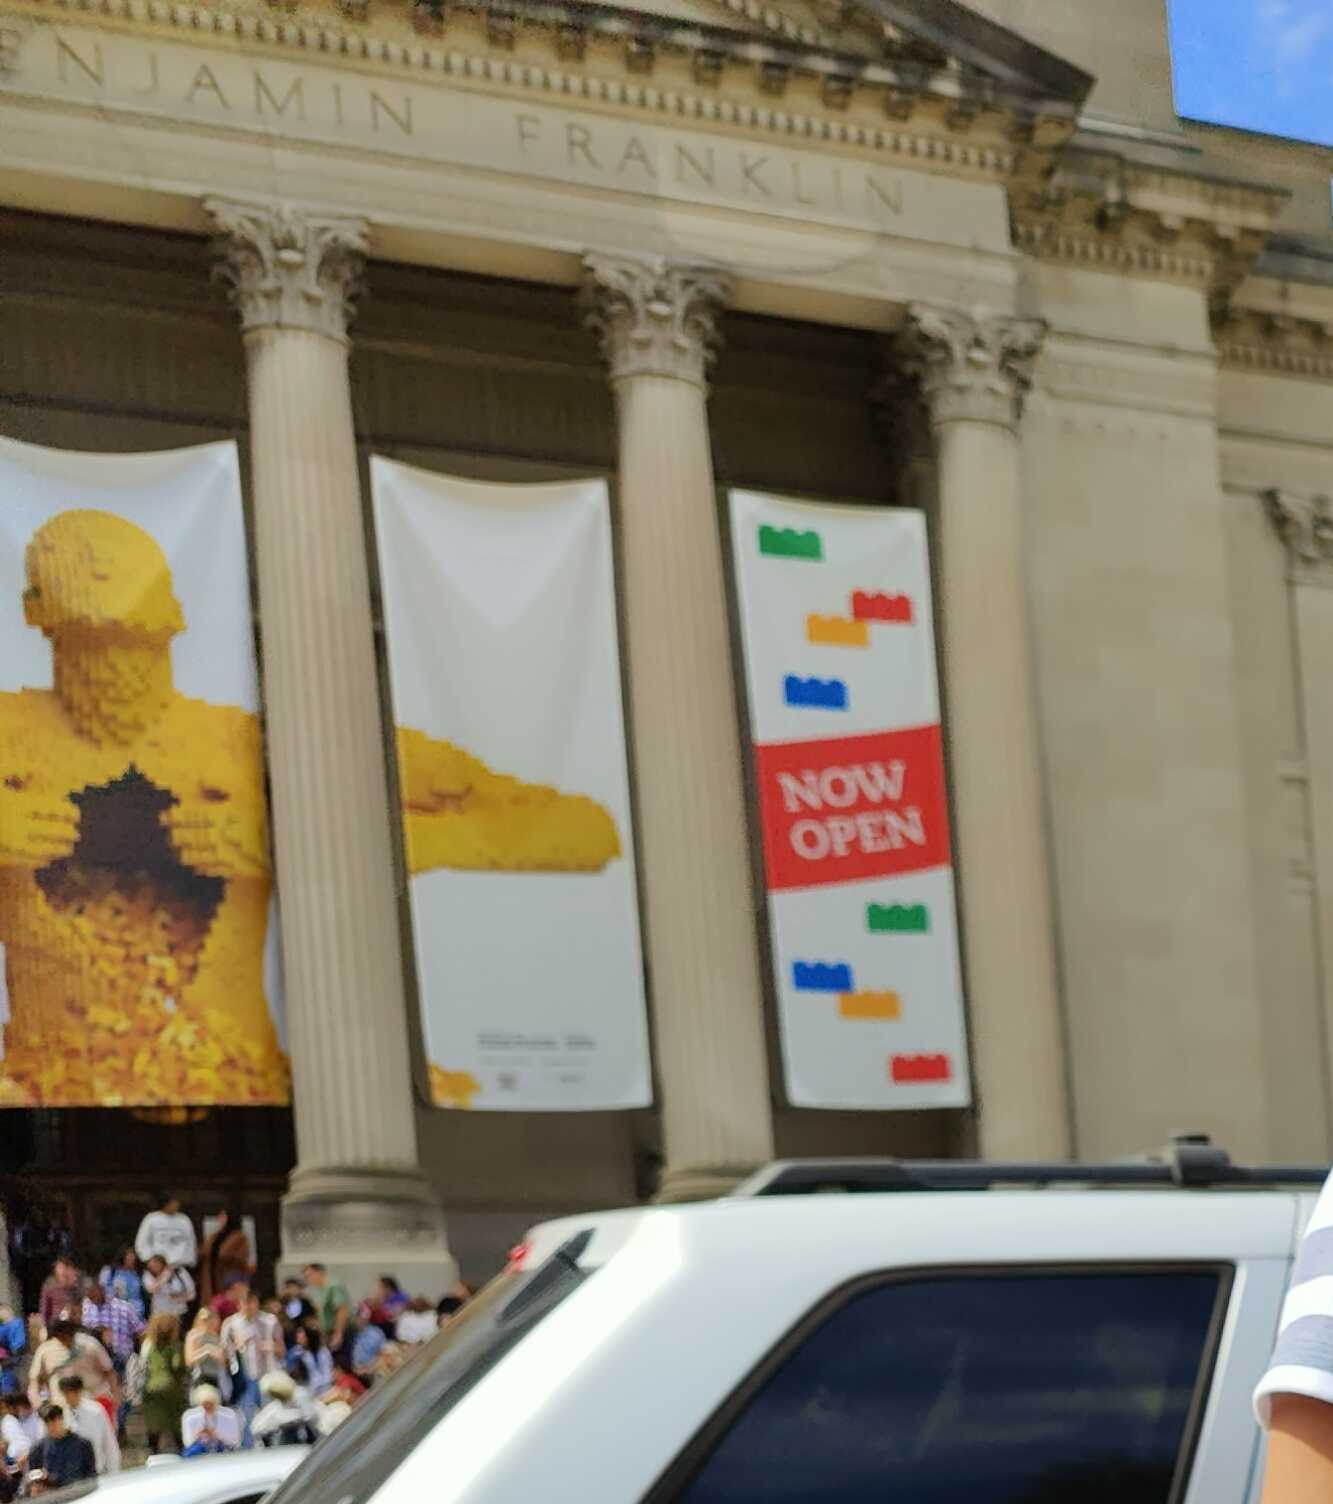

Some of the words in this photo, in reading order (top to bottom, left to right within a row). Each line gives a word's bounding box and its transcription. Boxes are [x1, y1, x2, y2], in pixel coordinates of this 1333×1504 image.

[514, 113, 905, 217] FRANKLIN
[776, 759, 906, 813] NOW
[789, 805, 926, 860] OPEN
